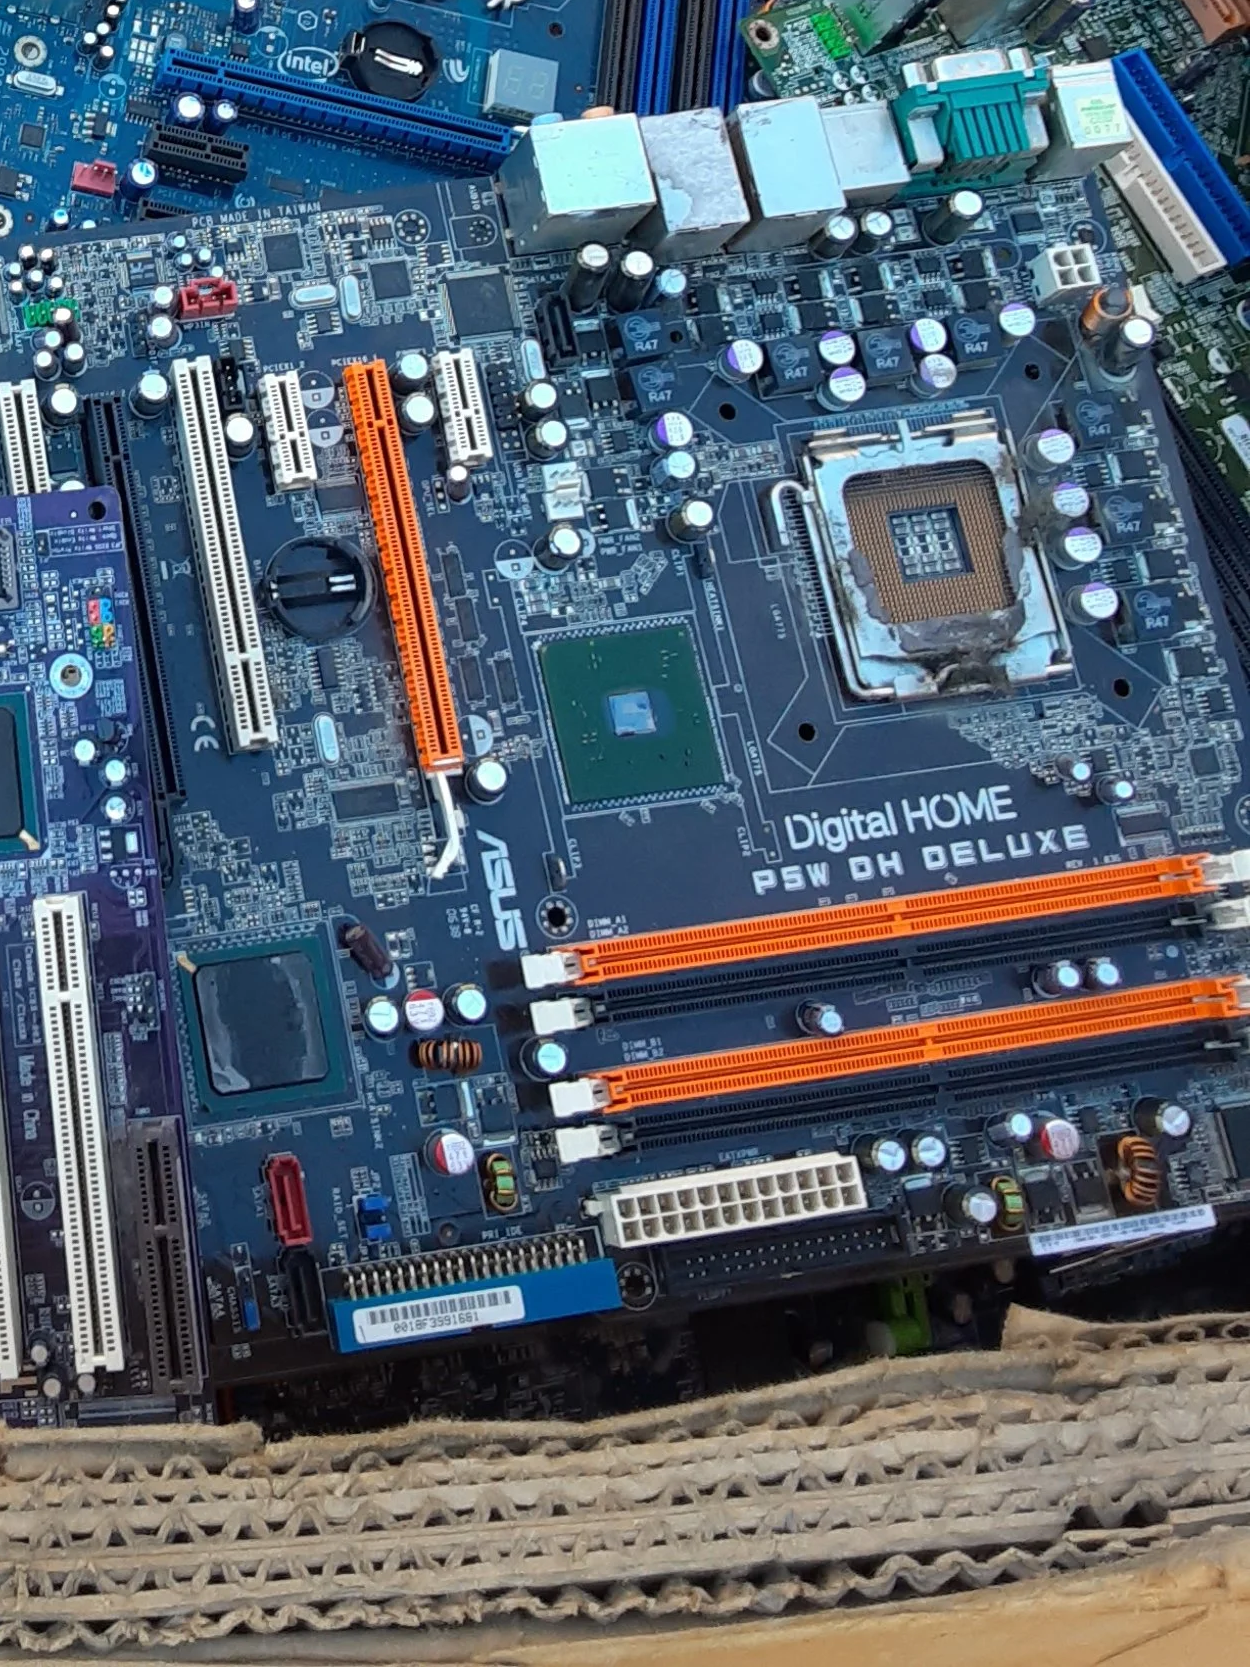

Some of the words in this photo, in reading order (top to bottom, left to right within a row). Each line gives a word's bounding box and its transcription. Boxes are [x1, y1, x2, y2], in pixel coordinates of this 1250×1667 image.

[284, 49, 331, 76] intel
[191, 215, 213, 228] PCB
[219, 210, 248, 224] MADE
[257, 208, 271, 219] IN
[277, 201, 321, 217] TAIWAN
[634, 340, 660, 353] R47
[963, 340, 990, 354] R47
[874, 356, 901, 370] R47
[782, 368, 809, 381] R47
[647, 389, 673, 403] R47
[1085, 424, 1111, 438] R47
[1115, 520, 1141, 534] R47
[1145, 614, 1171, 628] R47
[188, 713, 219, 752] CE
[785, 809, 900, 854] Digital
[903, 785, 1018, 838] HOME
[753, 858, 830, 895] P5W
[850, 851, 904, 884] DH
[922, 823, 1090, 873] DELUXE
[476, 828, 526, 952] ASUS
[586, 914, 626, 929] DIMM_A1
[588, 924, 629, 939] DIMM_A2
[621, 1036, 662, 1052] DIMM_B1
[622, 1047, 664, 1063] DIMM_B2
[18, 1054, 35, 1086] Made
[21, 1092, 37, 1102] in
[22, 1108, 40, 1140] China
[328, 1186, 348, 1239] RAID_SET
